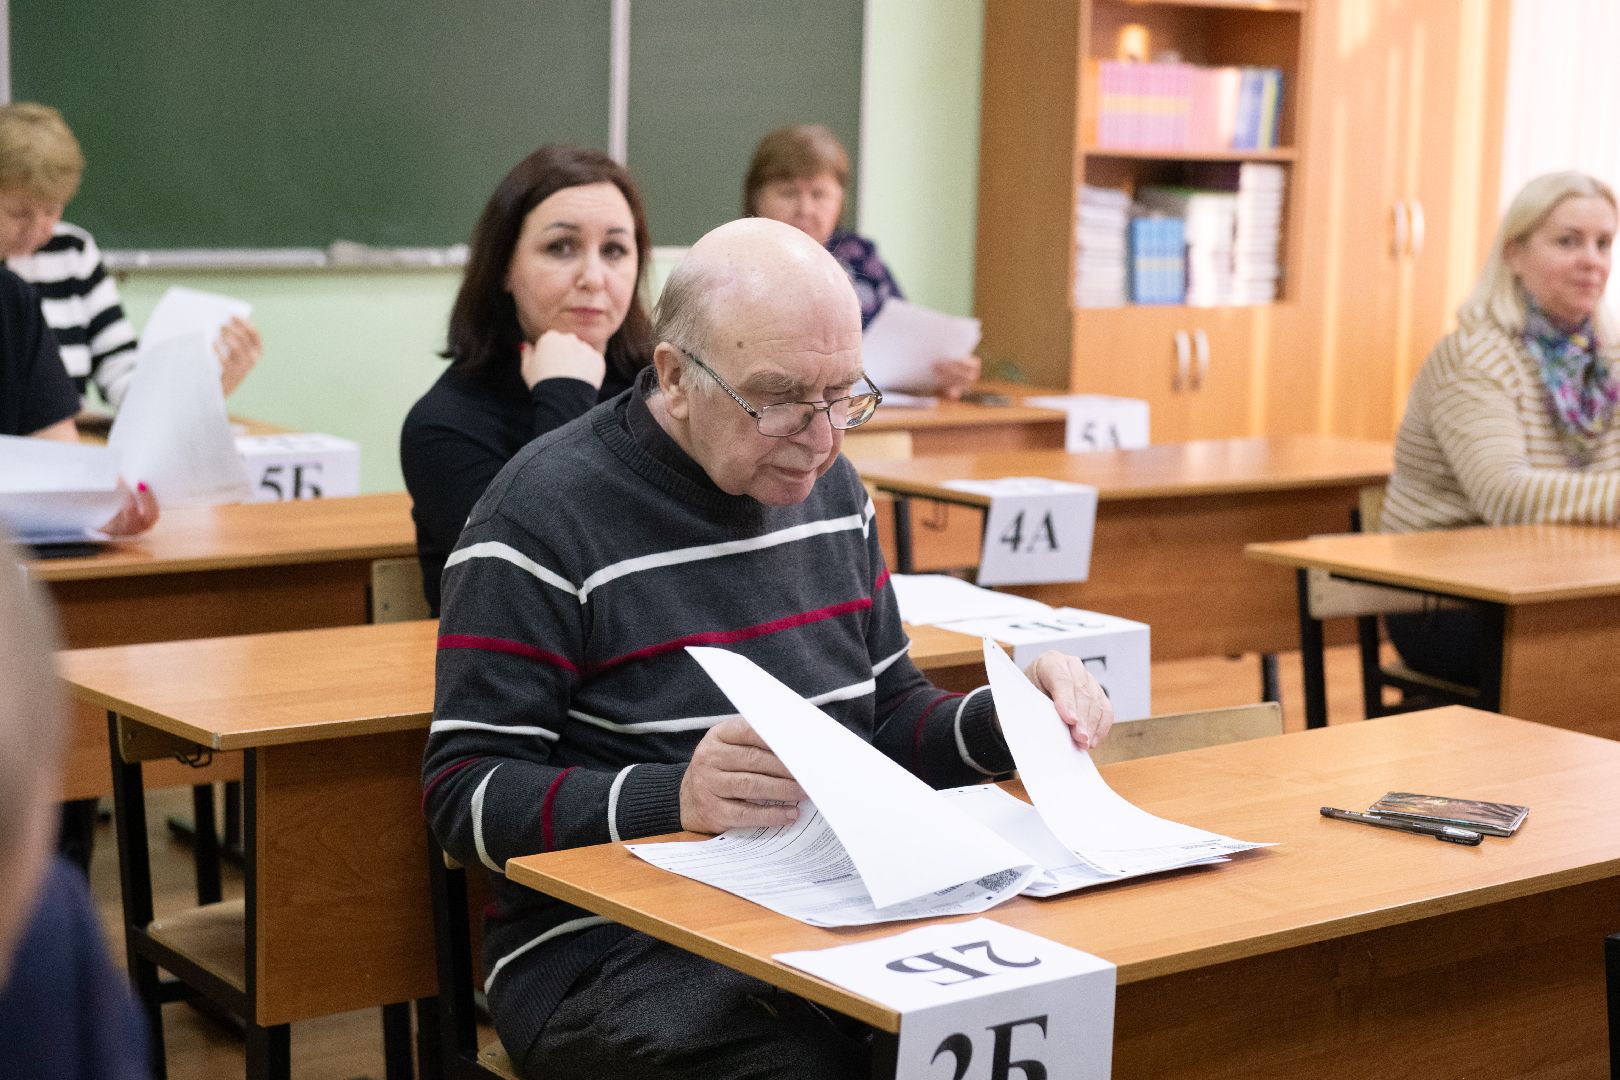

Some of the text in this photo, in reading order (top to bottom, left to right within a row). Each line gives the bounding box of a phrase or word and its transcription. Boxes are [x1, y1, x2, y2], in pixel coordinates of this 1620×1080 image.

[260, 463, 322, 499] 5Б
[1000, 509, 1059, 553] 4А
[886, 939, 1042, 986] 2Б
[929, 1014, 1049, 1080] 2Б
